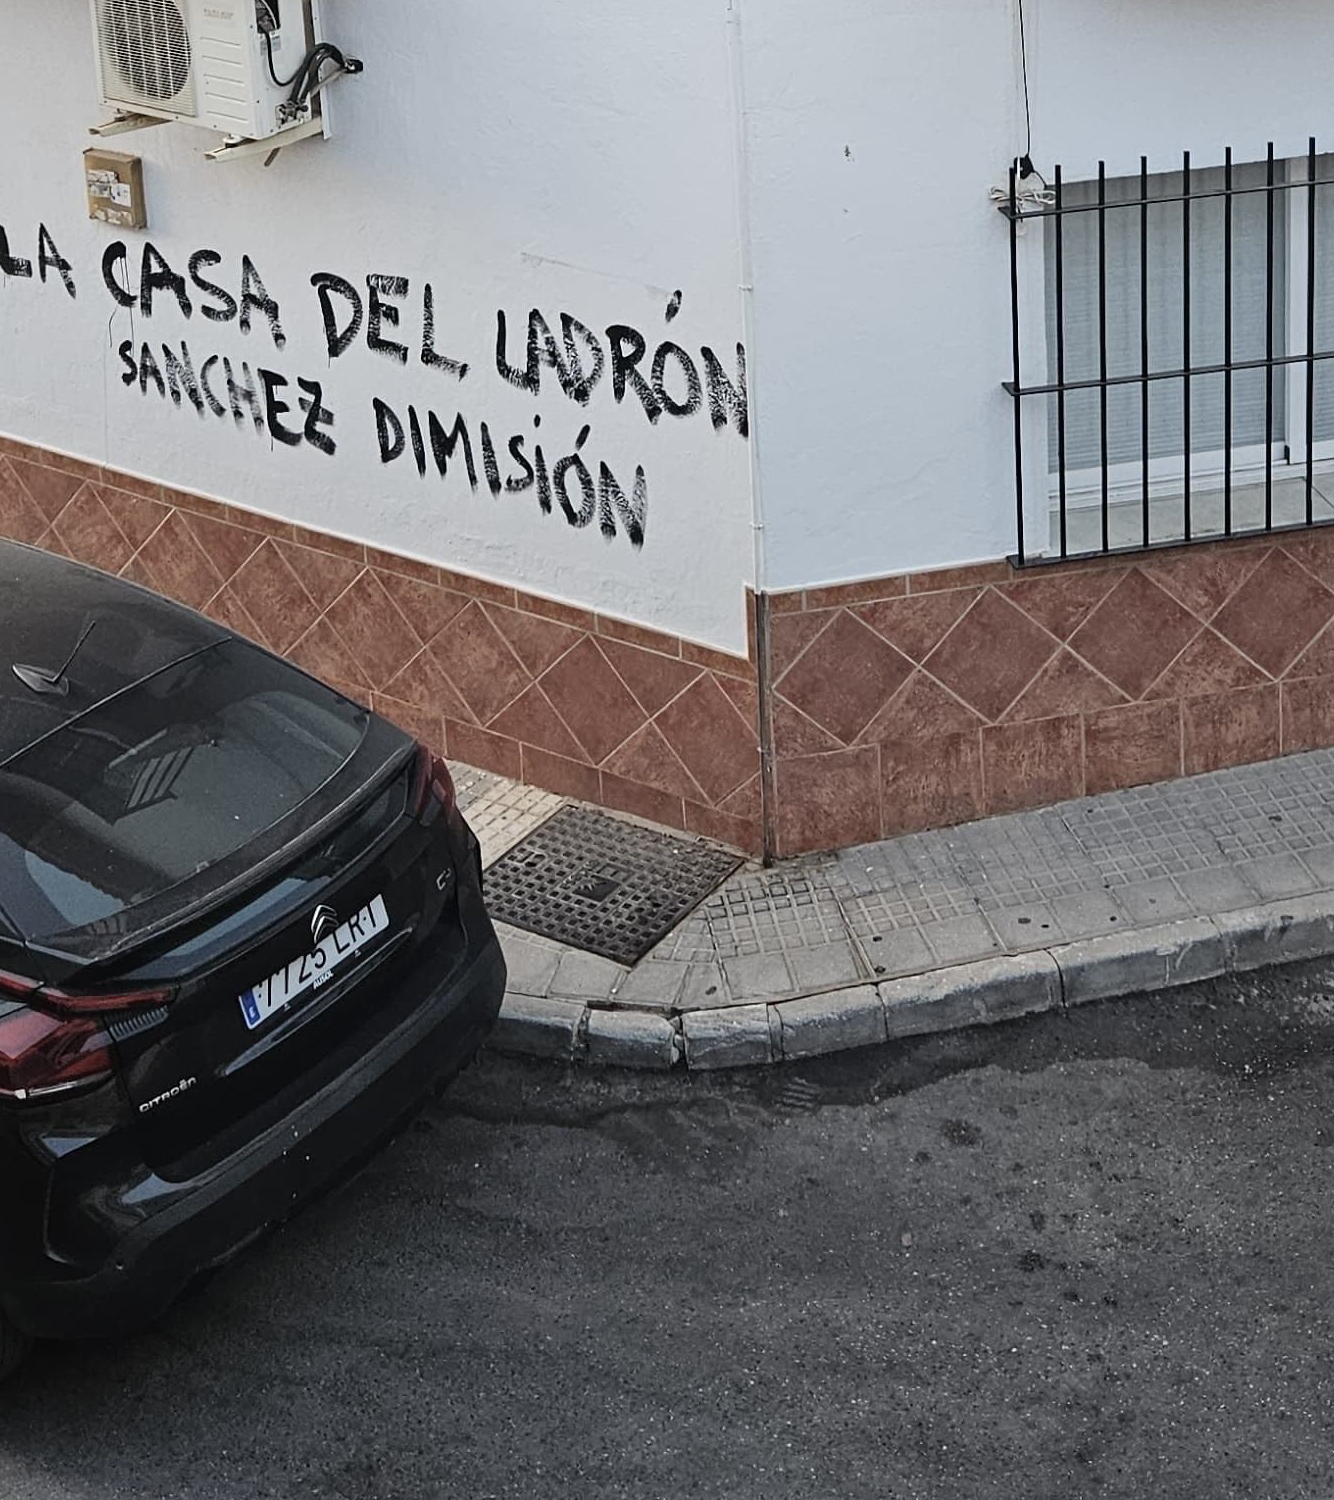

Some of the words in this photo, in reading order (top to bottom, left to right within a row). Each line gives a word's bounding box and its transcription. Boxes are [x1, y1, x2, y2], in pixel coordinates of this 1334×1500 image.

[102, 240, 287, 350] CASA
[311, 272, 469, 382] DEL
[496, 289, 749, 441] LADRÓN
[118, 340, 337, 456] SANCHEZ
[313, 970, 335, 990] AUSOL
[139, 1076, 197, 1113] CITROËN
